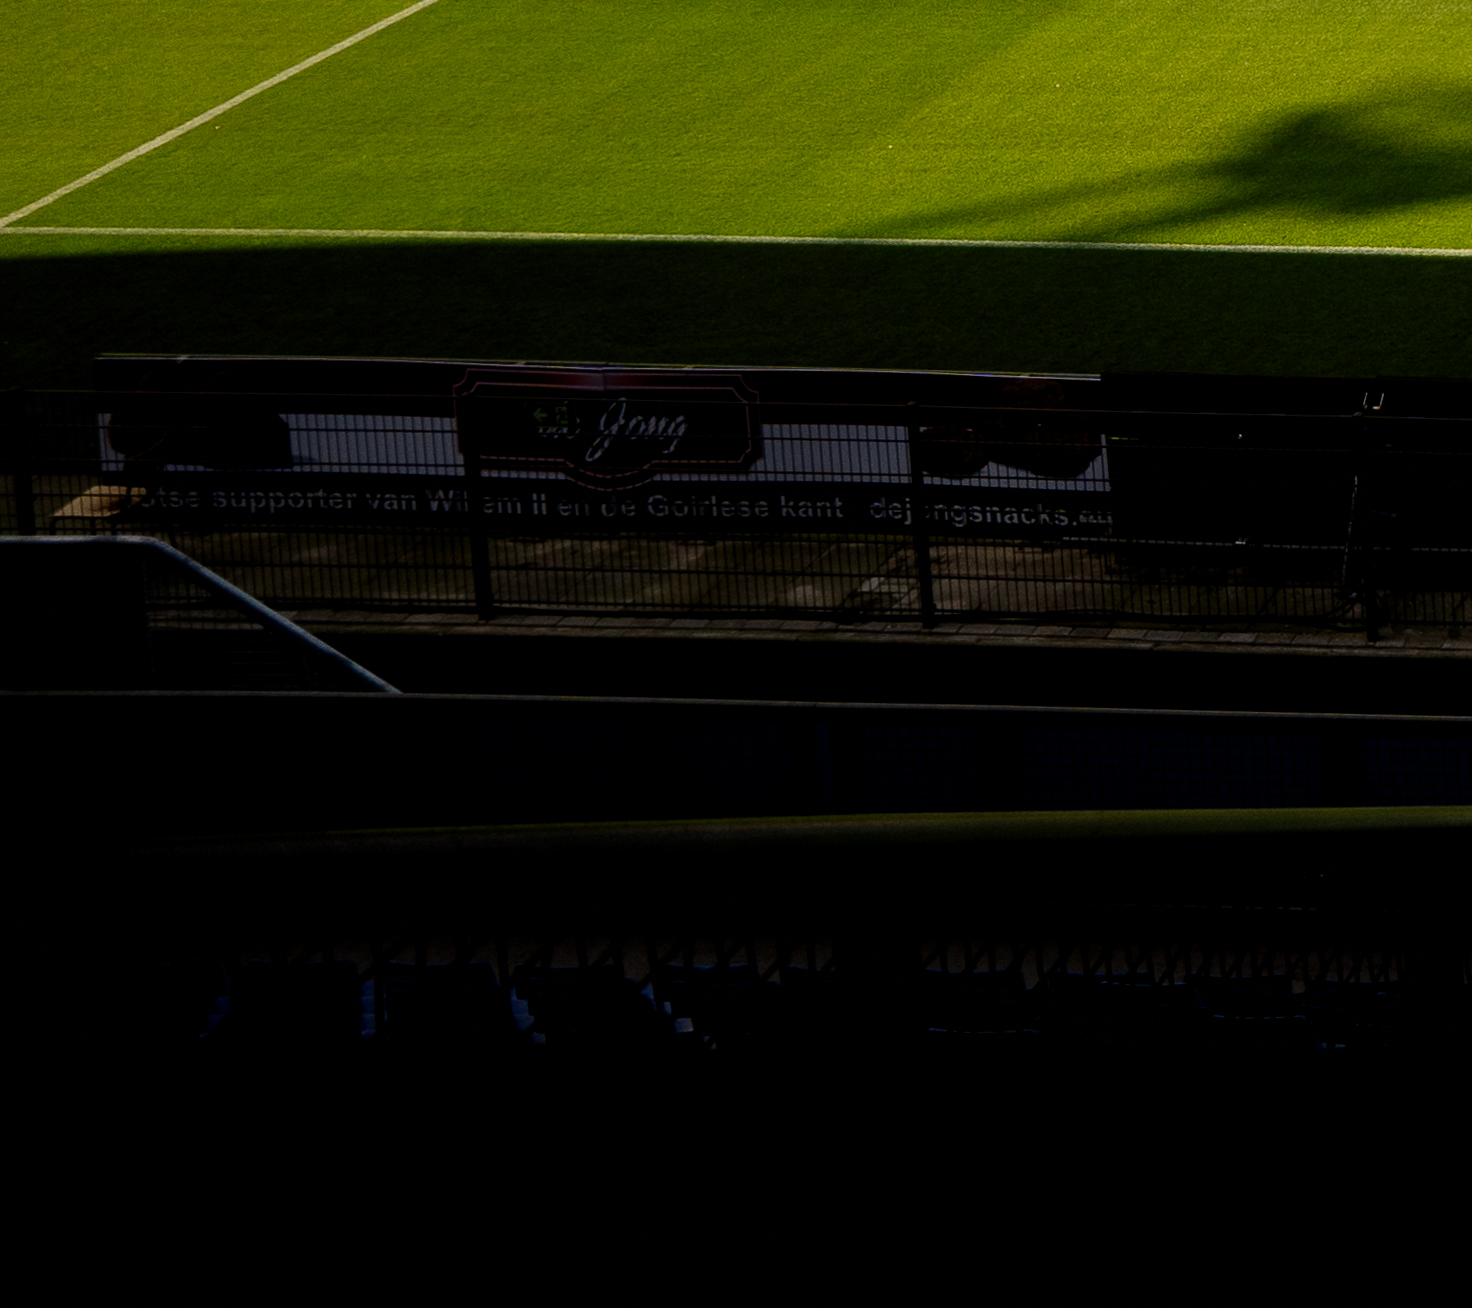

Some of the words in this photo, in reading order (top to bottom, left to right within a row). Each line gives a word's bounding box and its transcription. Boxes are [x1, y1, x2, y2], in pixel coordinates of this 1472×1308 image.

[212, 489, 358, 515] supporter
[366, 492, 417, 510] van
[424, 489, 522, 515] Wilem
[781, 495, 843, 519] kant
